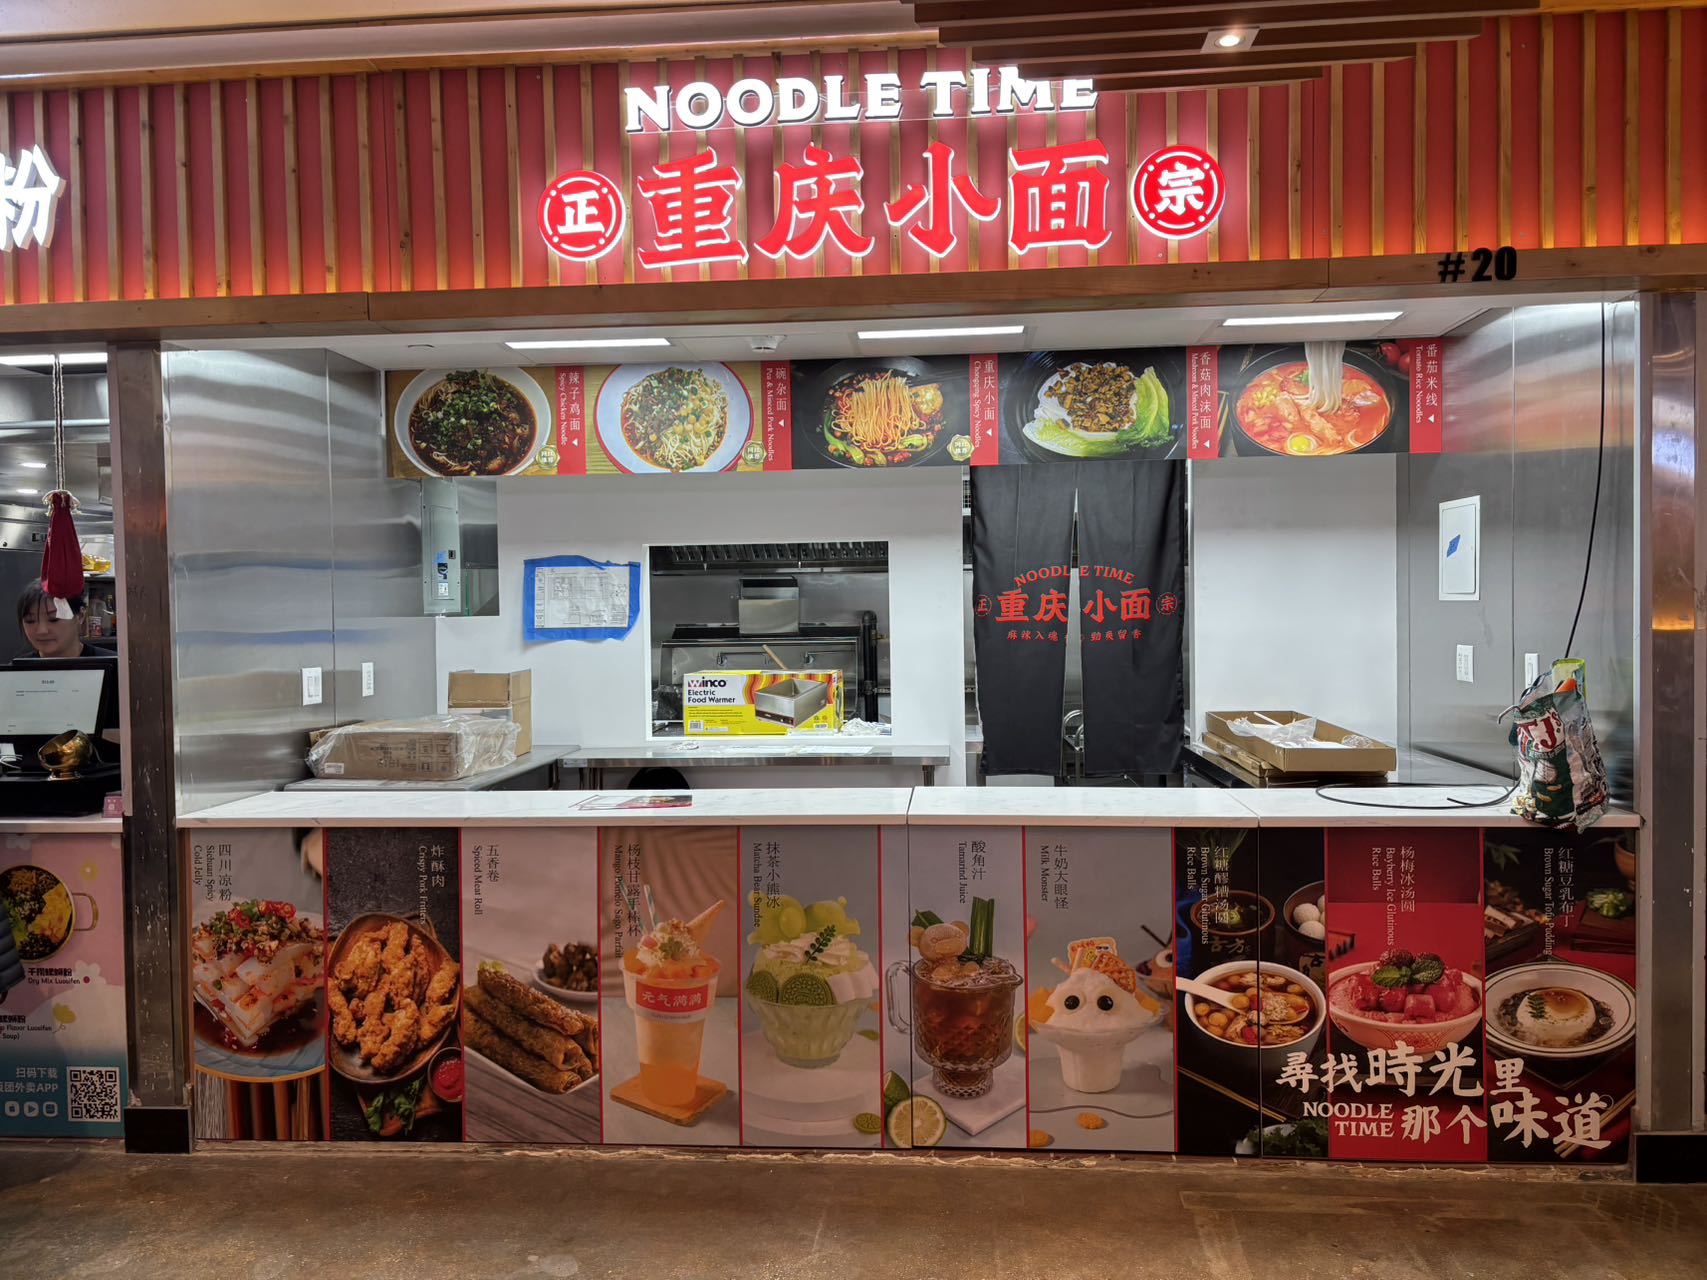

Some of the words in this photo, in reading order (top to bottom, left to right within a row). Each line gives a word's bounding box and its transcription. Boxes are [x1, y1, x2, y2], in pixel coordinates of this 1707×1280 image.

[624, 72, 903, 135] NOODLE
[920, 63, 1099, 119] TIME
[0, 143, 66, 252] 粉
[556, 189, 603, 236] 正
[636, 137, 1113, 269] 重庆小面
[1155, 165, 1205, 212] 宗
[1438, 246, 1517, 283] #20
[1191, 353, 1199, 383] Mushroom
[1415, 345, 1423, 371] Tomato
[559, 373, 567, 391] Spicy
[973, 360, 982, 398] Chongqing
[1415, 373, 1423, 390] Rice
[1426, 344, 1439, 406] 番茄米线
[984, 360, 996, 421] 重庆小面
[560, 393, 568, 420] Chicken
[973, 399, 983, 419] Spicy
[768, 434, 776, 462] Noodles
[974, 420, 982, 448] Noodles
[1013, 565, 1090, 589] NOODLE
[1094, 565, 1136, 586] TIME
[194, 845, 203, 864] Cold
[206, 844, 215, 877] Sichuan
[417, 845, 428, 873] Crispy
[430, 844, 446, 888] 炸酥肉
[473, 845, 482, 873] Spiced
[486, 844, 500, 882] 五香卷
[613, 845, 623, 873] Mango
[753, 843, 762, 873] Matcha
[958, 842, 967, 881] Tamarind
[971, 840, 987, 880] 酸角汁
[1041, 845, 1050, 865] Milk
[1187, 847, 1196, 866] Rice
[1201, 847, 1210, 878] Brown
[1372, 847, 1381, 867] Rice
[1384, 847, 1396, 885] Bayberry
[1544, 848, 1554, 875] Brown
[193, 866, 203, 885] Jelly
[218, 844, 232, 901] 四川凉粉
[419, 875, 428, 894] Pork
[474, 875, 483, 896] Meat
[754, 876, 763, 894] Bear
[766, 842, 781, 909] 抹茶小熊冰
[1041, 868, 1050, 902] Monster
[1054, 844, 1069, 909] 牛奶大眼怪
[1187, 868, 1197, 890] Balls
[1372, 869, 1382, 890] Balls
[1400, 846, 1415, 912] 杨梅冰汤圆
[205, 879, 215, 902] Spicy
[615, 876, 623, 907] Pomelo
[958, 883, 968, 904] Juice
[1199, 879, 1210, 902] Sugar
[1387, 889, 1396, 902] Ice
[1542, 876, 1554, 900] Sugar
[1558, 847, 1575, 927] 红糖豆乳布丁
[419, 896, 429, 925] Fritters
[474, 898, 483, 915] Roll
[613, 909, 623, 929] Sago
[754, 897, 763, 928] Sundae
[1201, 904, 1210, 945] Glutinous
[1386, 904, 1397, 946] Glutinous
[1542, 922, 1556, 955] Pudding
[615, 932, 624, 959] Parfait
[28, 977, 40, 986] Dry
[55, 977, 81, 985] Luosifen
[15, 1067, 58, 1079] 扫码下载
[1275, 1039, 1531, 1098] 尋找時光里
[1302, 1102, 1394, 1120] NOODLE
[1400, 1091, 1612, 1150] 那个味道
[1334, 1121, 1395, 1138] TIME
